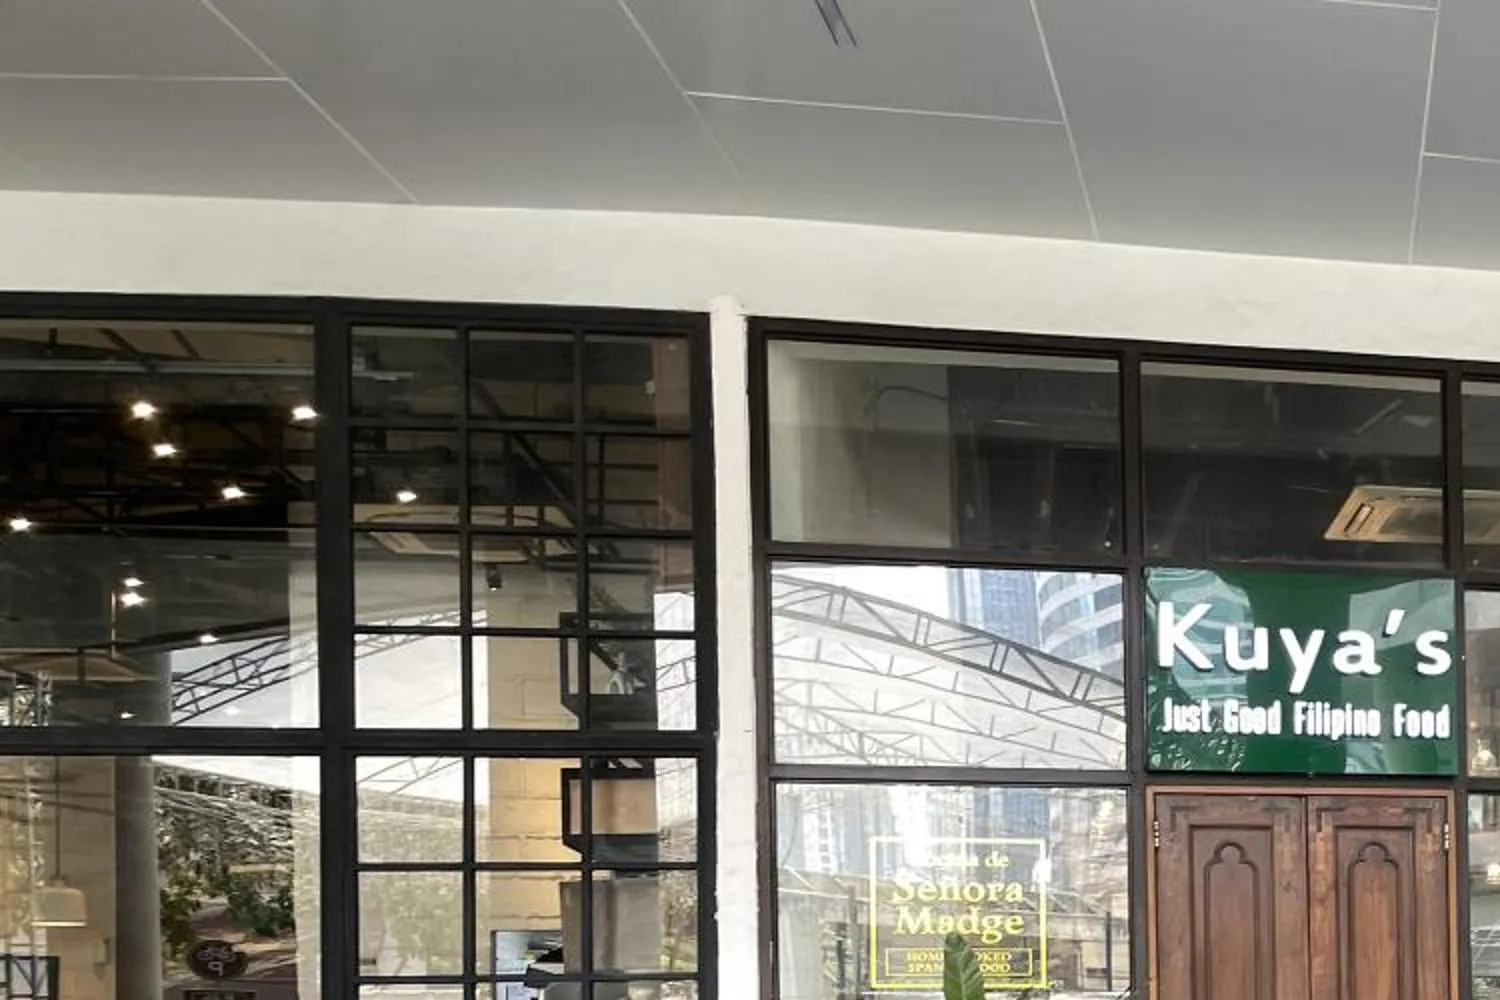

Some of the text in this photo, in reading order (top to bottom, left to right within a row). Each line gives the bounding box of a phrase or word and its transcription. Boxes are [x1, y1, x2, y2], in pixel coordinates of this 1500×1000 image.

[1157, 601, 1452, 694] Kuya's
[1163, 698, 1452, 741] Just Good Filipino Food
[894, 905, 1025, 944] Madge
[980, 962, 1011, 973] OOD
